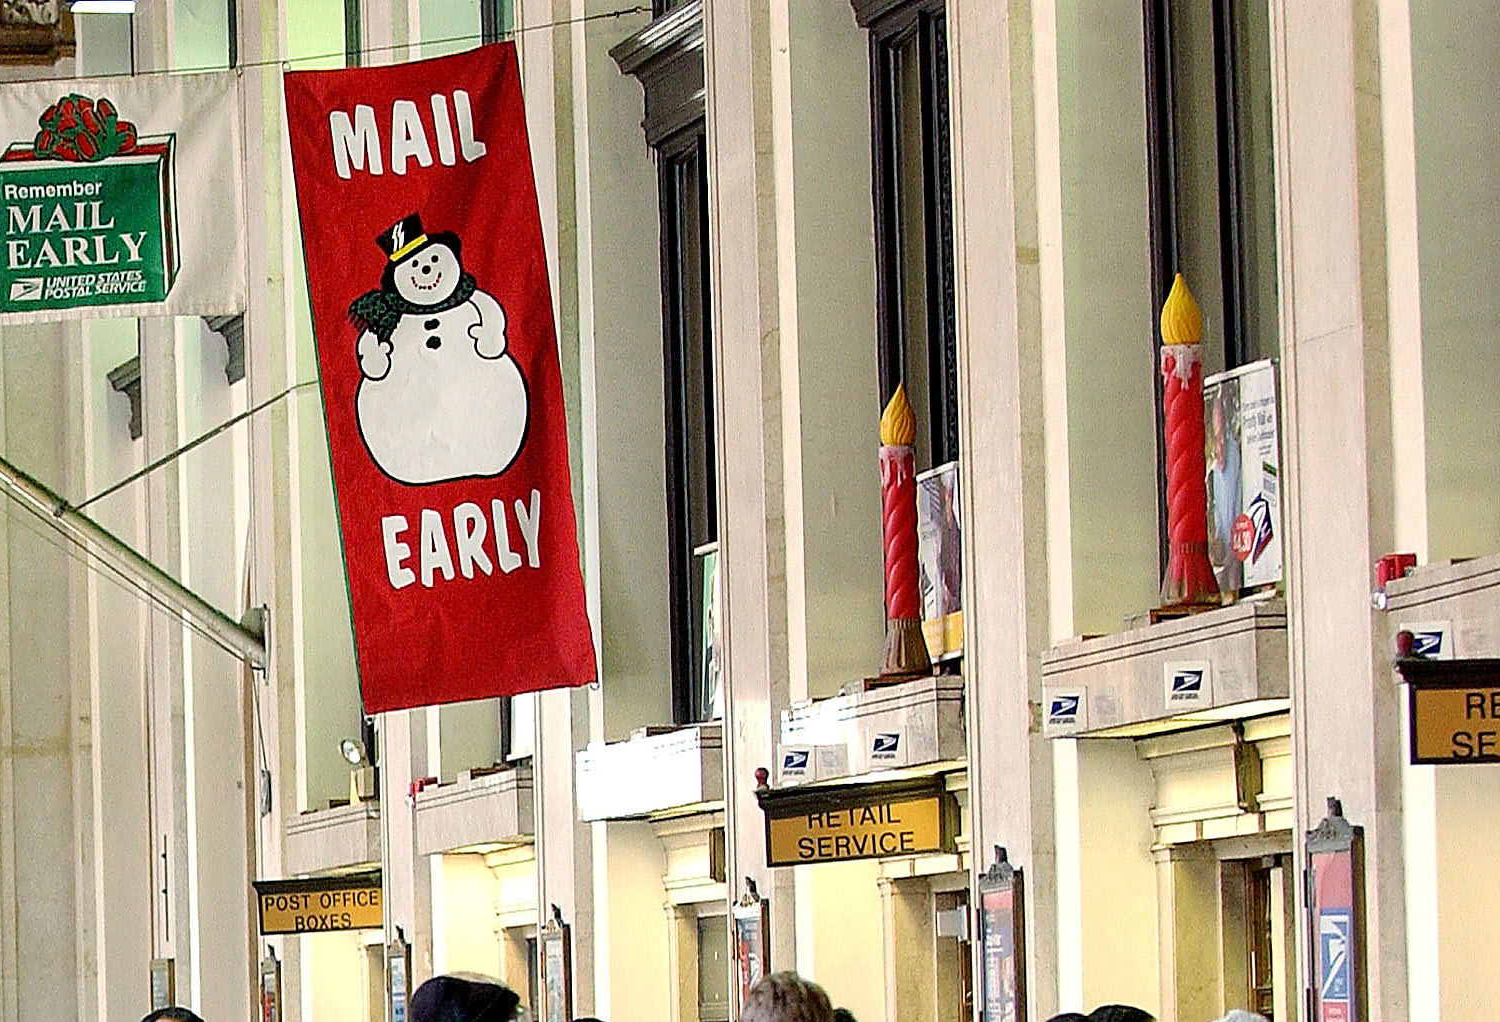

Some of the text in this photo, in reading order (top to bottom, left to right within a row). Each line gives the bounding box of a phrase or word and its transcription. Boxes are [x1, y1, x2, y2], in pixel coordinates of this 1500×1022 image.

[328, 90, 487, 180] MAIL
[4, 180, 103, 200] Remember
[6, 200, 115, 235] MAIL
[6, 231, 147, 270] EARLY
[44, 280, 146, 300] POSTAL SERVICE
[46, 270, 142, 288] UNITED STATES
[380, 489, 542, 589] EARLY
[807, 803, 901, 829] RETAIL
[797, 831, 915, 859] SERVICE
[265, 889, 379, 912] POST OFFICE
[294, 912, 352, 931] BOXES
